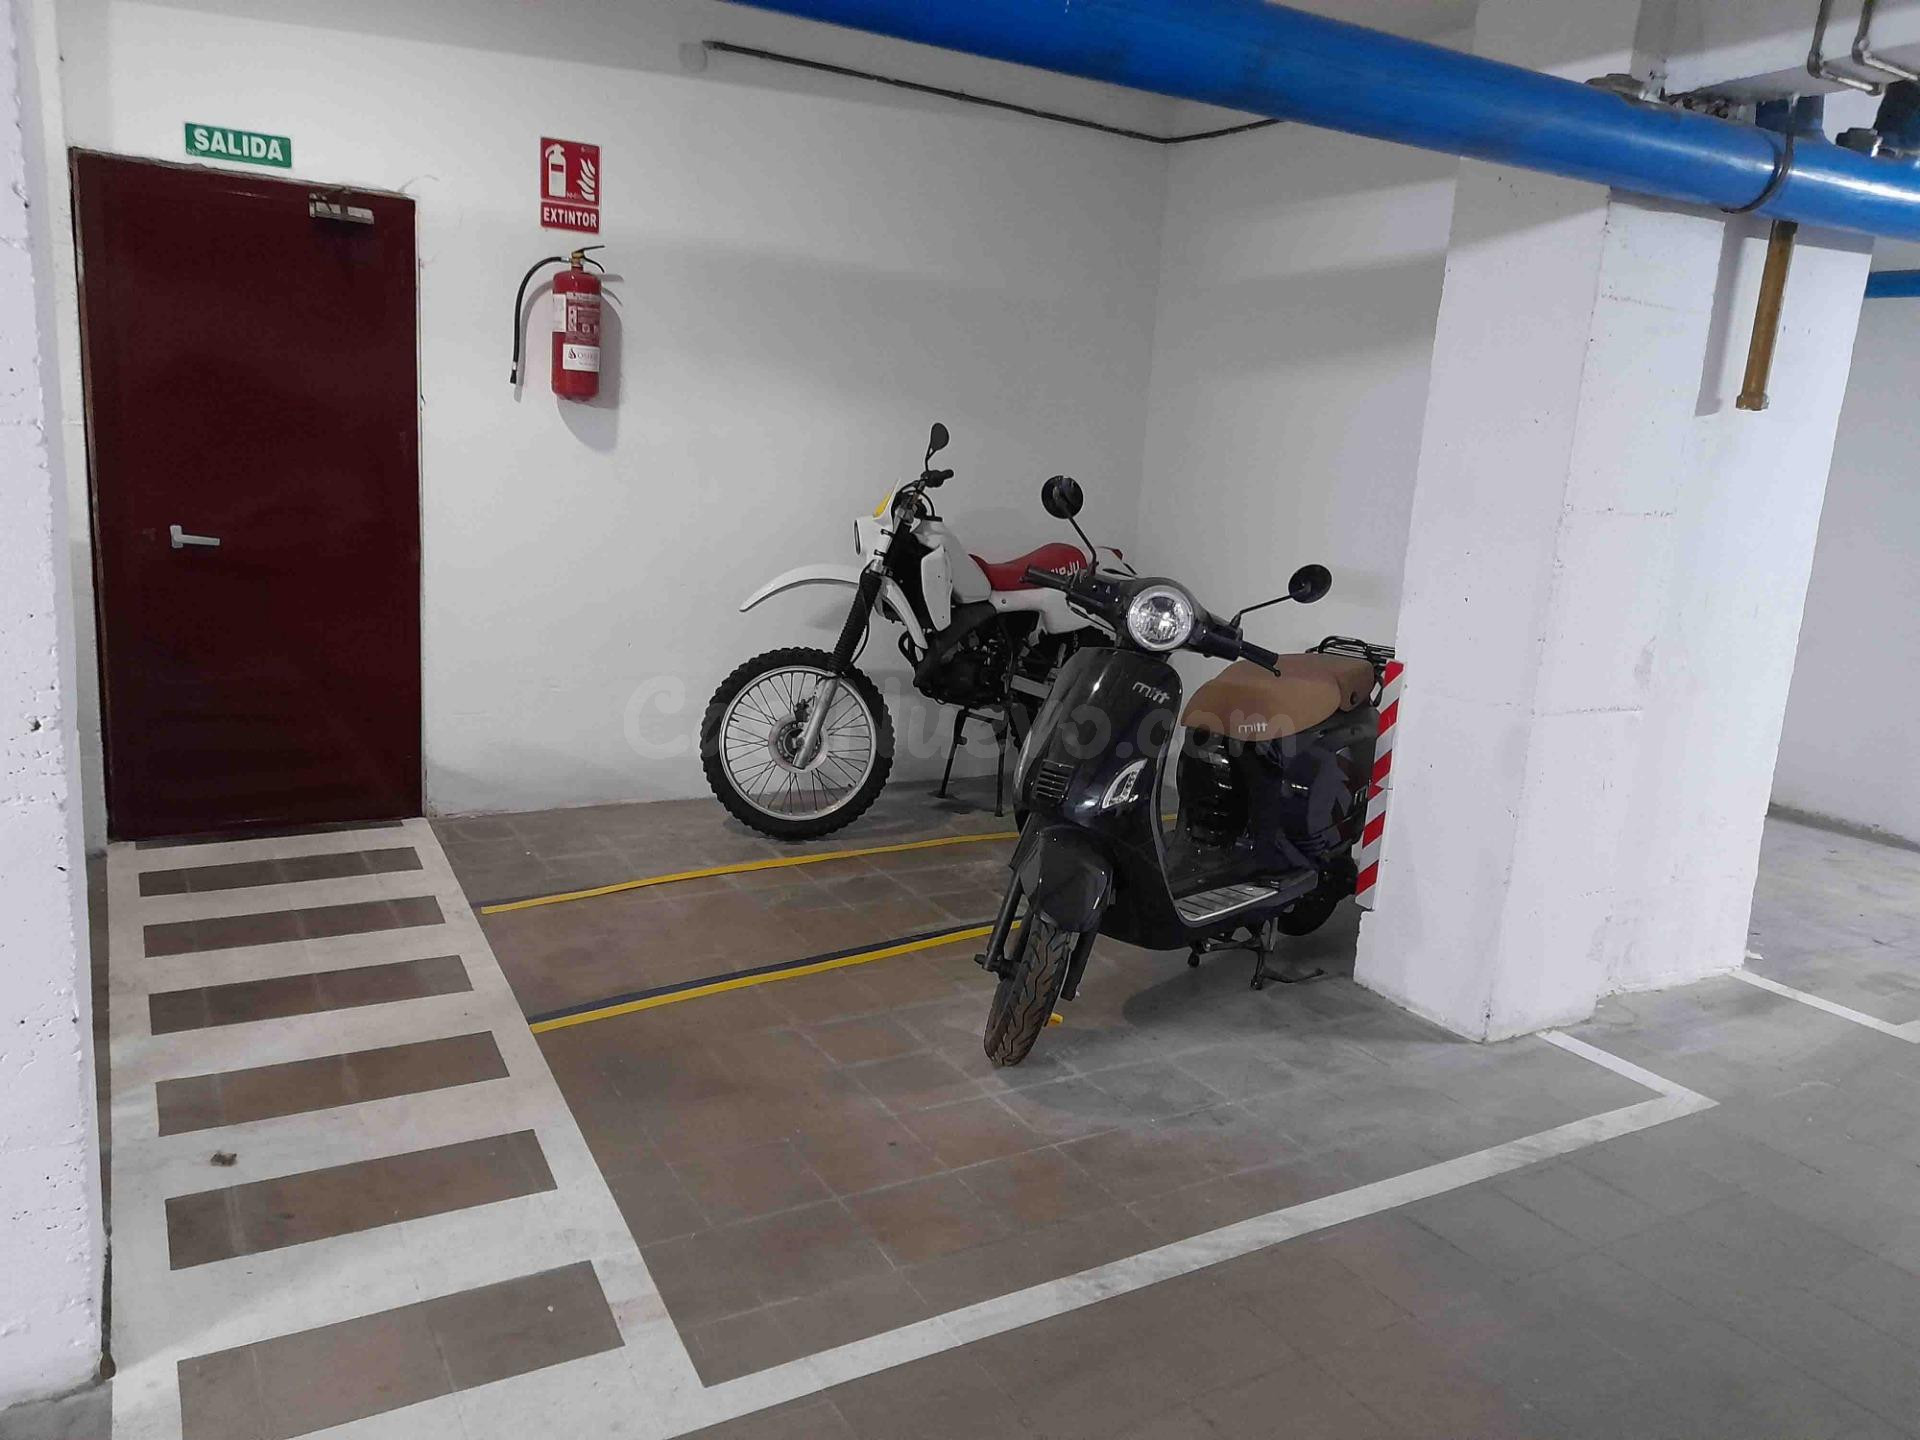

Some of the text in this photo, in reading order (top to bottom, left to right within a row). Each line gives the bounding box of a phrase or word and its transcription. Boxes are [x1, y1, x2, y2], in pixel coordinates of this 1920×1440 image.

[193, 127, 284, 162] SALIDA
[543, 206, 598, 228] EXTINTOR
[1132, 681, 1170, 704] mitt
[1238, 721, 1268, 734] mitt
